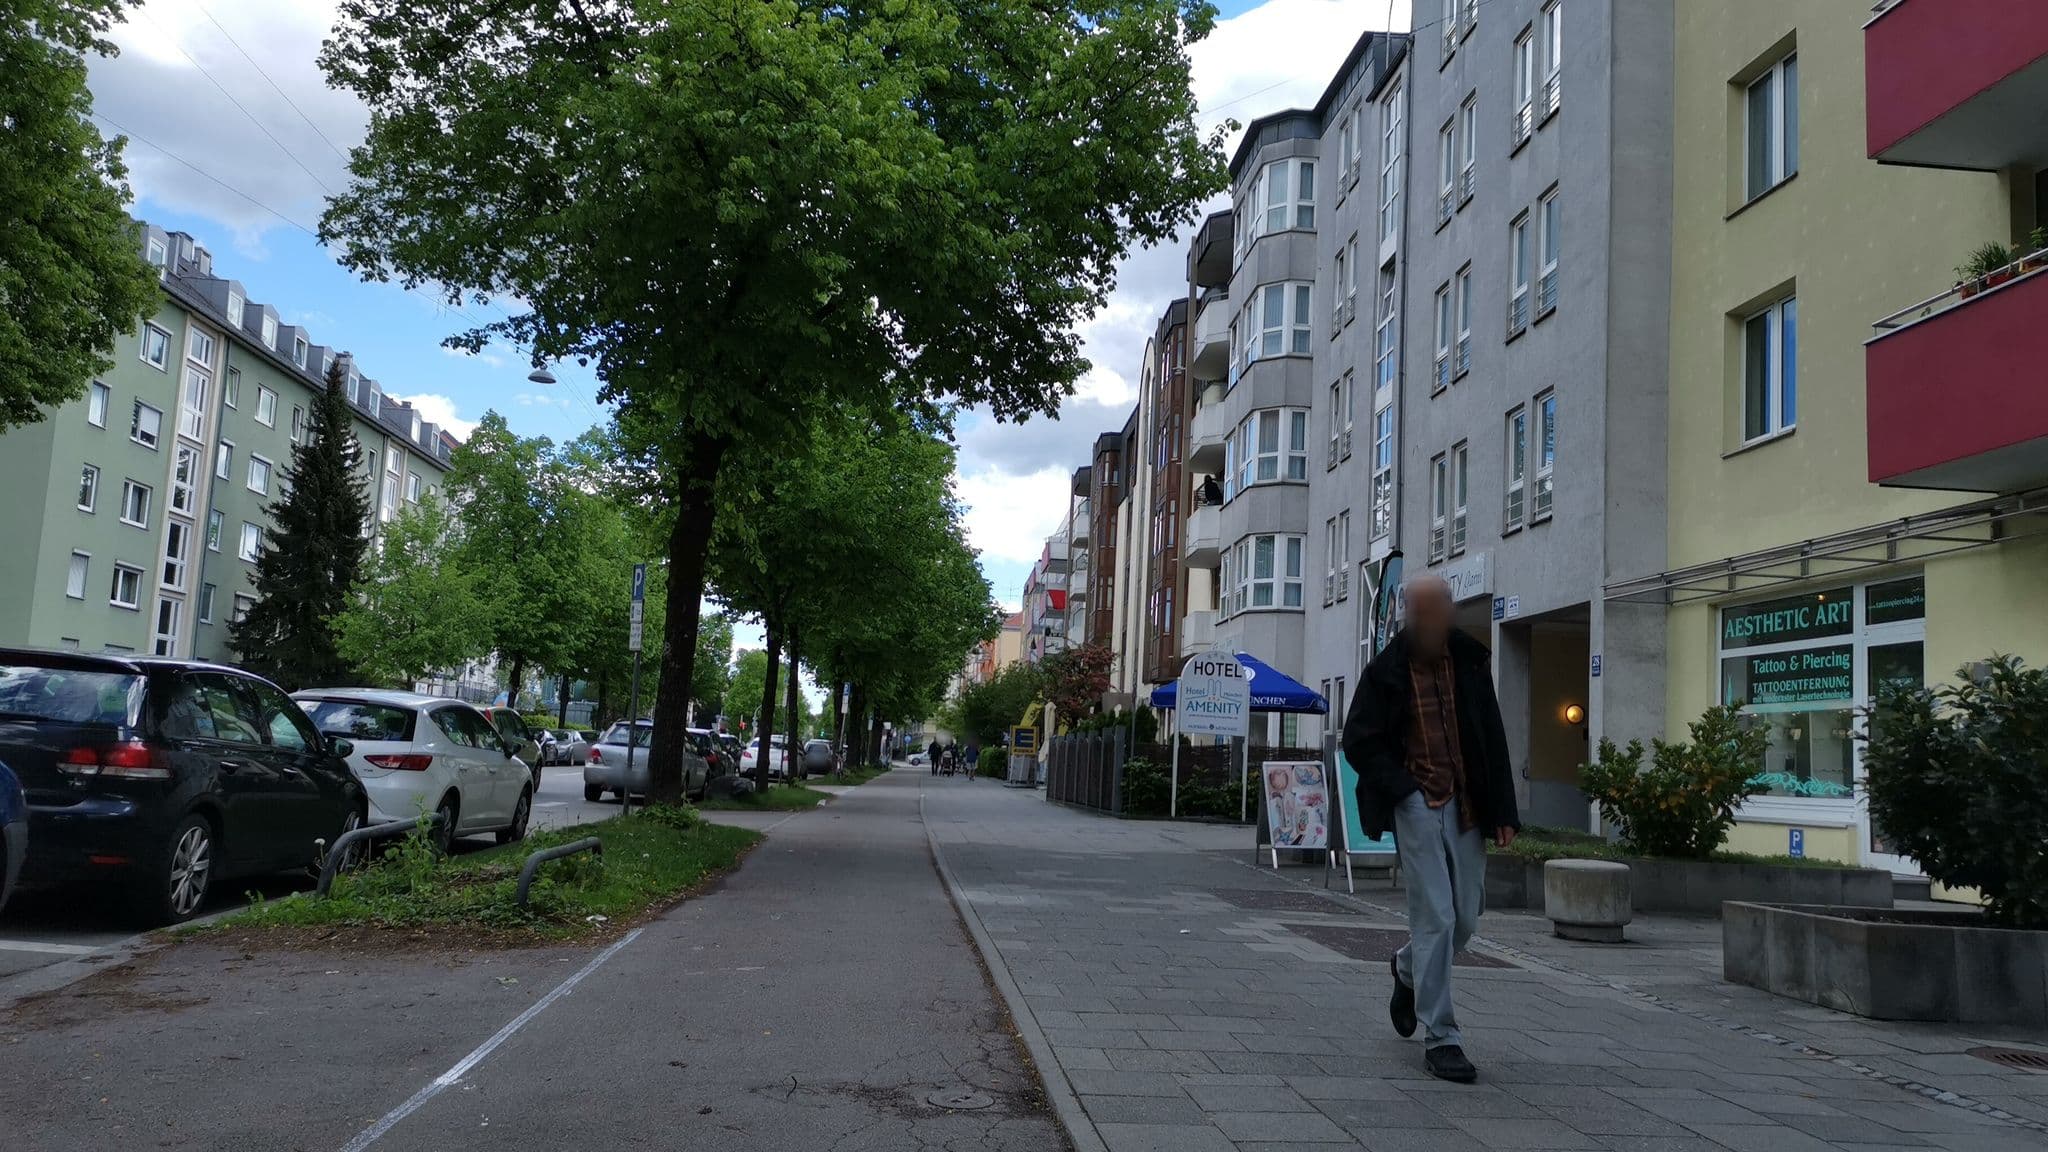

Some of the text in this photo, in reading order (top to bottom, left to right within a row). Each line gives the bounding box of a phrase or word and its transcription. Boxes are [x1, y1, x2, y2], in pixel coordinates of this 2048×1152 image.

[633, 568, 643, 597] P
[1725, 600, 1851, 639] AESTHETIC ART
[1193, 660, 1242, 678] HOTEL
[1752, 651, 1850, 674] Tattoo & Piercing
[1185, 686, 1205, 695] Hotel
[1752, 675, 1850, 693] TATTOOENTFERNUNG
[1250, 696, 1287, 705] NCHEN
[1797, 689, 1850, 701] Lasertechnologie
[1185, 700, 1242, 715] AMENITY
[1792, 831, 1801, 848] P
